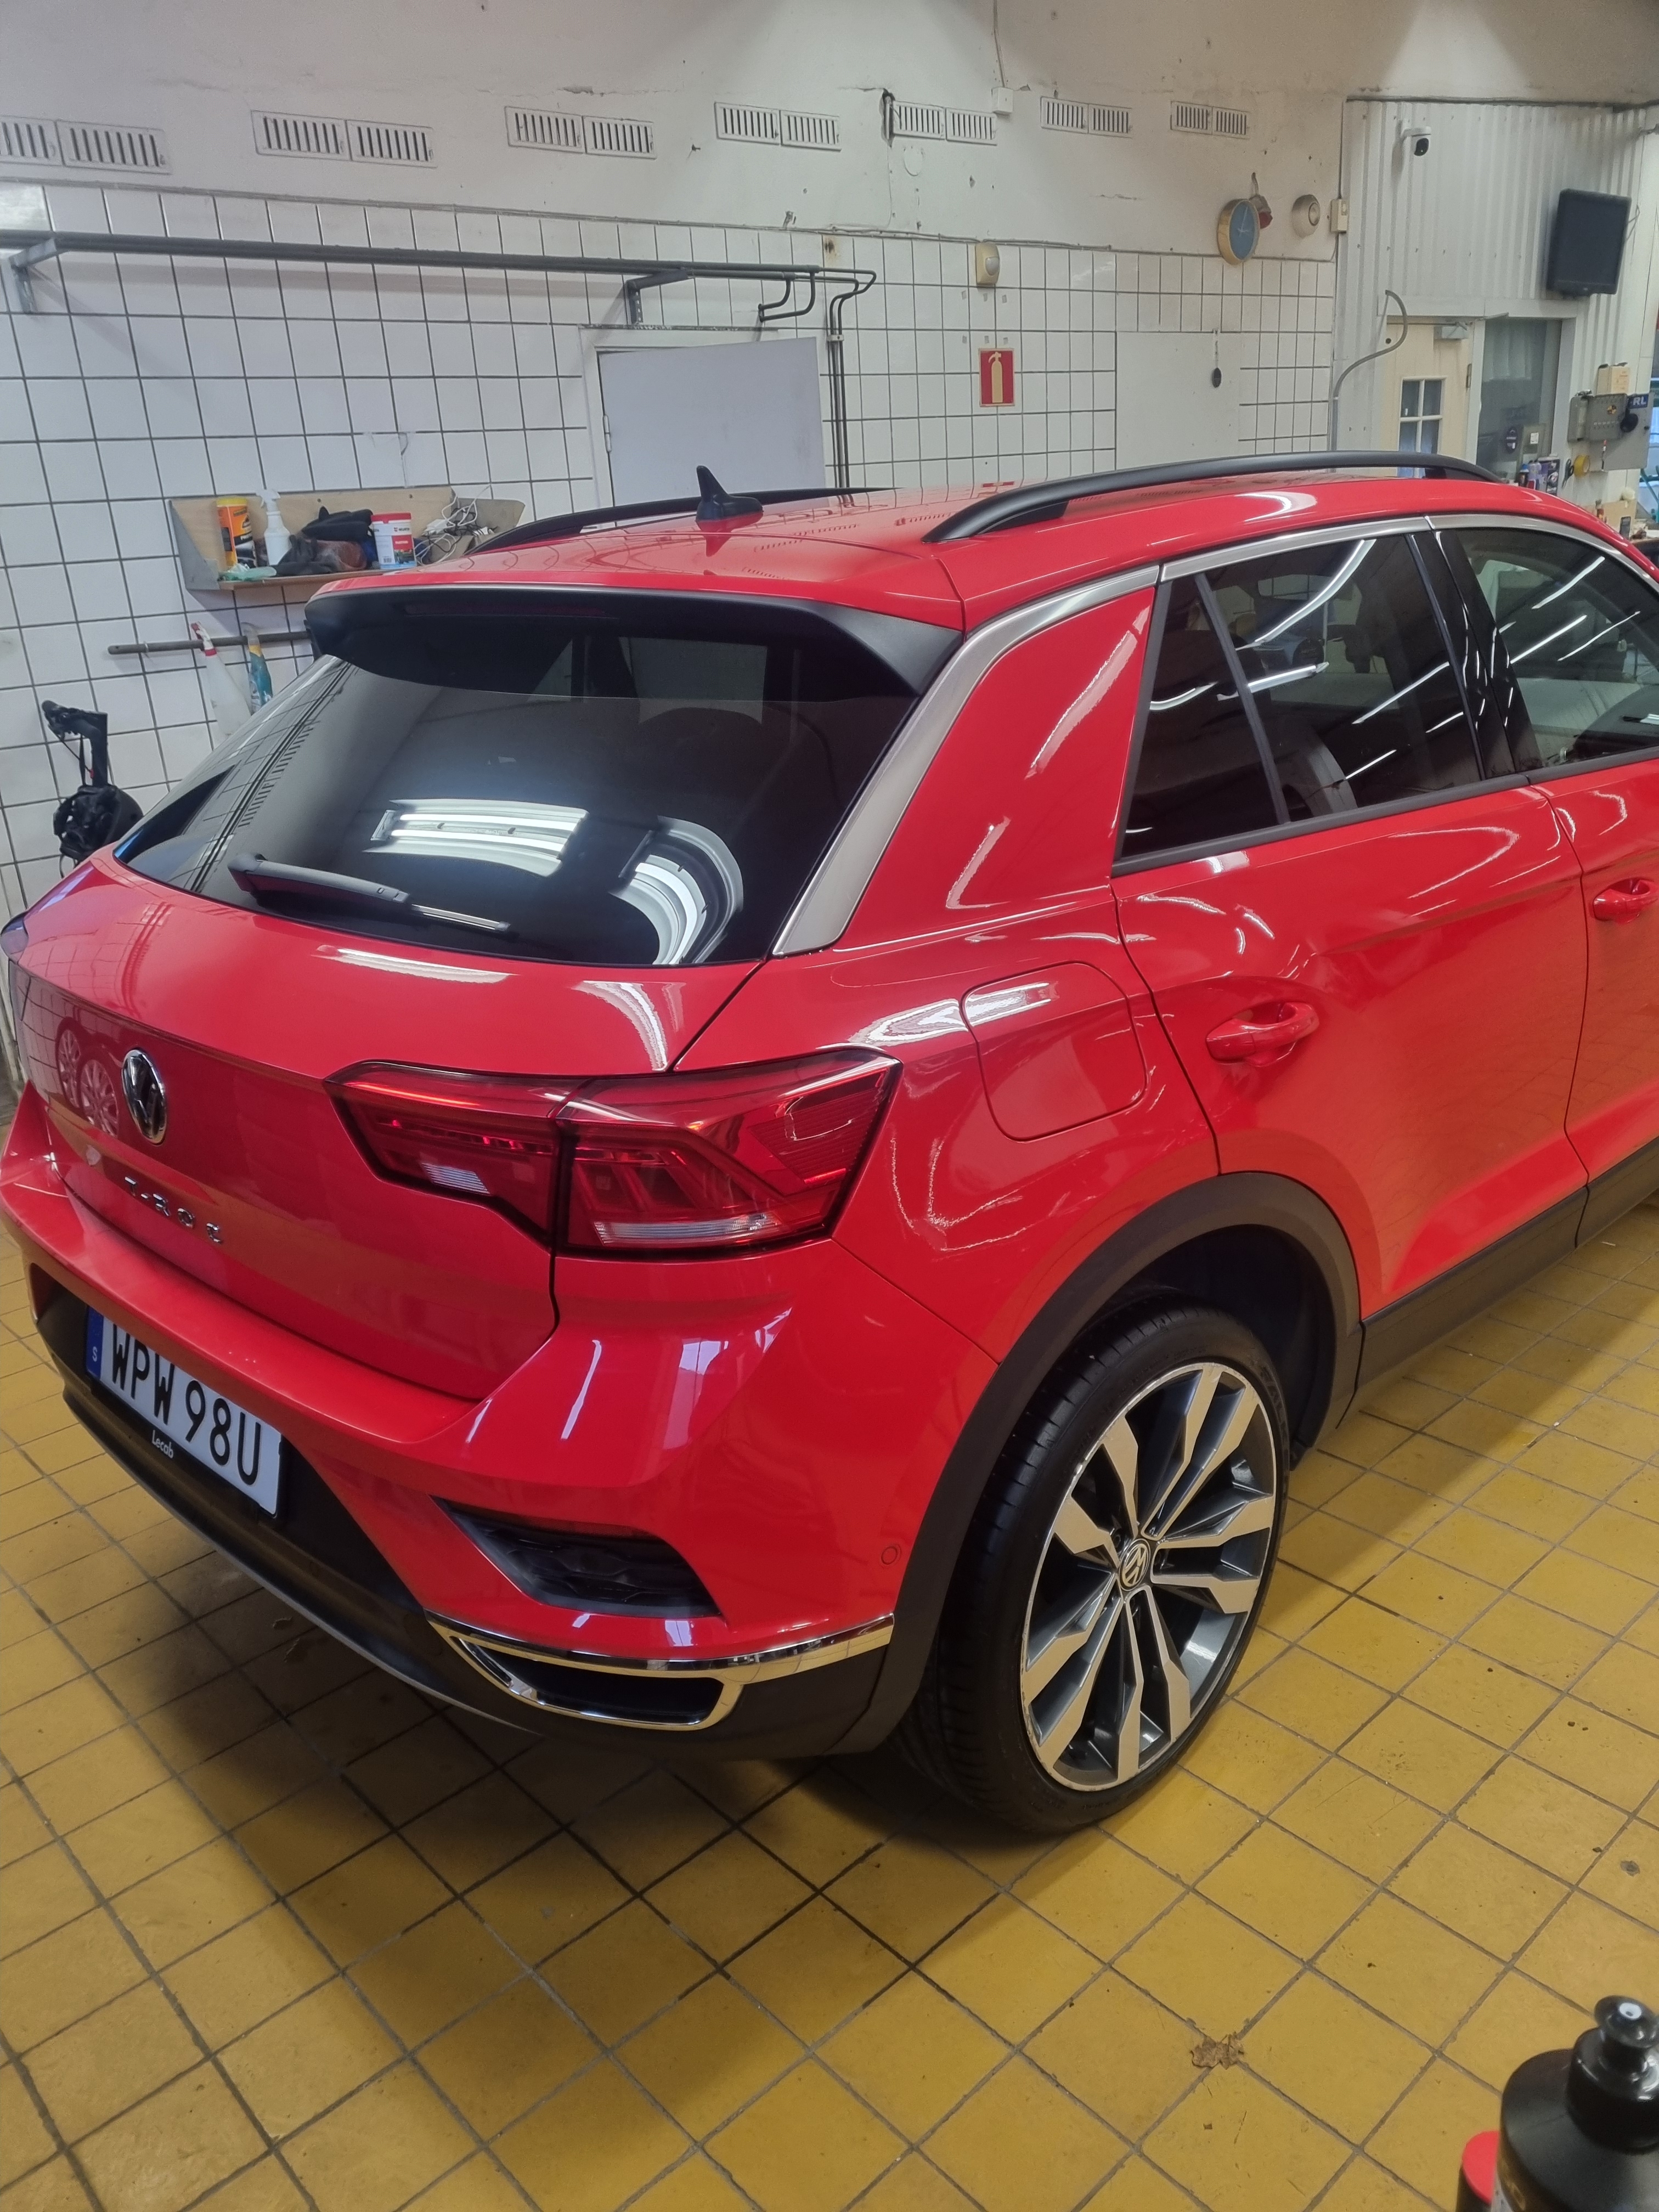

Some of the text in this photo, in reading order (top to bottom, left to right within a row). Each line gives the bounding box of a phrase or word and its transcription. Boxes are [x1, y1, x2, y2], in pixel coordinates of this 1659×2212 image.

[125, 1176, 223, 1244] T-ROC
[92, 1346, 98, 1362] S
[112, 1323, 261, 1486] WPW 98U
[152, 1430, 174, 1459] Lecab
